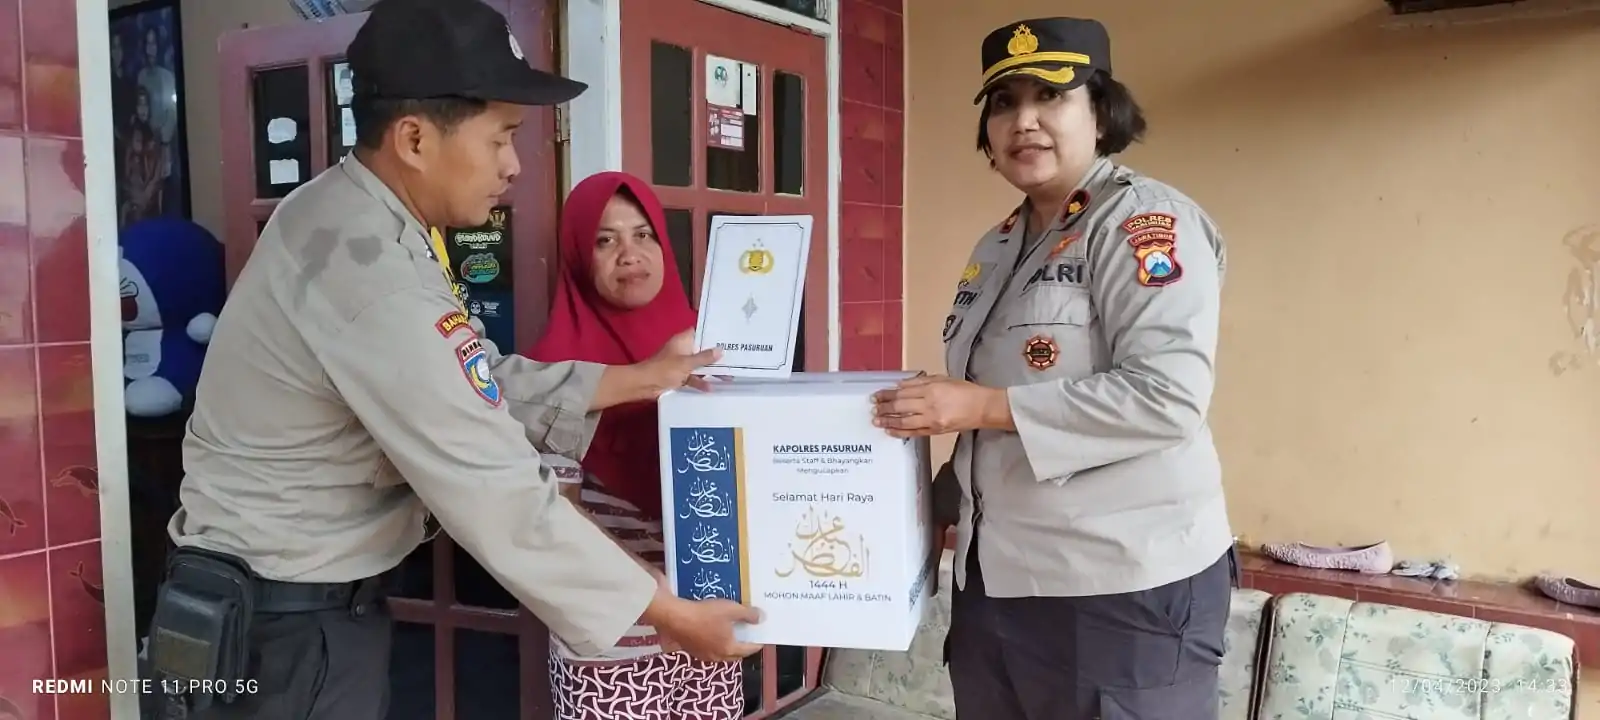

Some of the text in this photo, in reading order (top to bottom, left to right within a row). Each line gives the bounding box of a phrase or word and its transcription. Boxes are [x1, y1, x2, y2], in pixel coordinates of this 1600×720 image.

[740, 343, 773, 352] PASURUAN
[773, 444, 872, 453] KAPOLRES PASURUAN
[772, 492, 874, 504] Selamat Hari Raya
[809, 580, 847, 589] 1444 H
[764, 591, 799, 600] MOHON
[800, 592, 826, 600] MAAF
[828, 592, 855, 601] LAHIR
[864, 593, 892, 602] BATIN
